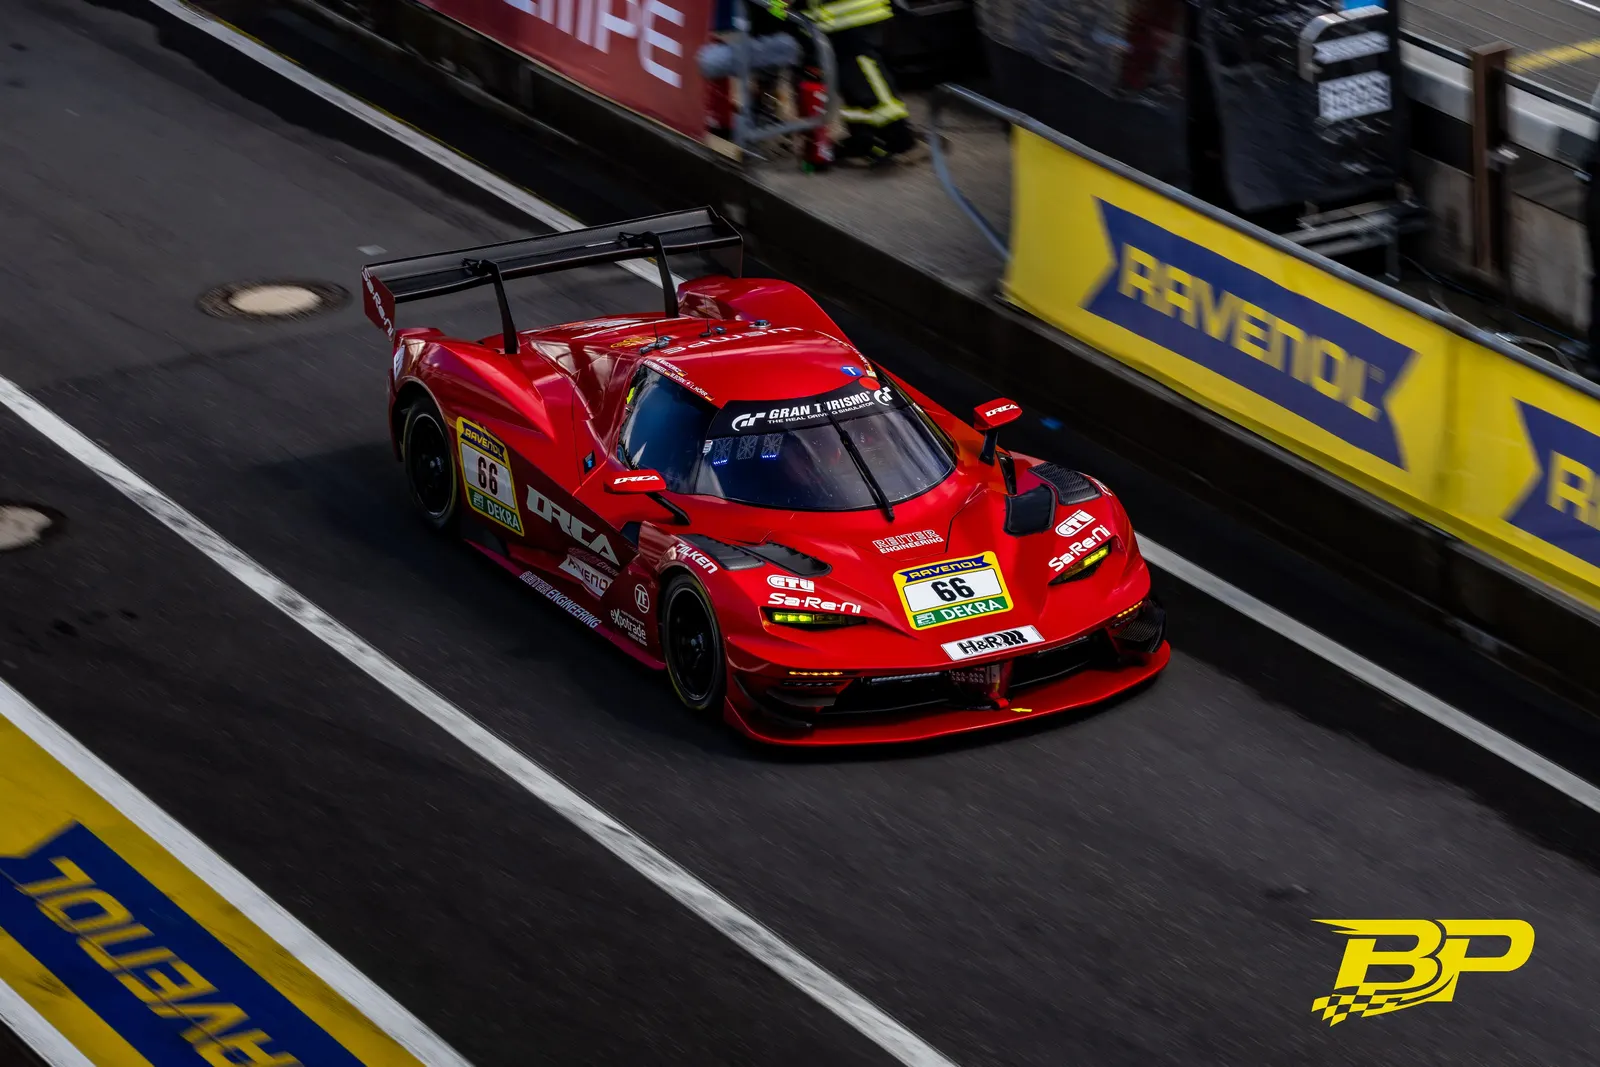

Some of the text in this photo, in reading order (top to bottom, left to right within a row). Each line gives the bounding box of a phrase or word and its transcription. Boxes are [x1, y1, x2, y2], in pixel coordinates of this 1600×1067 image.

[1118, 243, 1381, 421] RAVENOL
[842, 366, 856, 376] T
[769, 405, 811, 420] GRAN
[807, 410, 837, 419] DRIVIG
[838, 401, 875, 413] SIMULATOR
[465, 428, 503, 457] RAVENOL
[478, 456, 498, 496] 66
[487, 500, 520, 531] DEKRA
[1055, 509, 1096, 537] GTU
[872, 529, 940, 549] REITER
[879, 537, 944, 554] ENGINEERING
[675, 543, 718, 574] FALKEN
[909, 560, 985, 580] RAVENOL
[767, 575, 815, 593] GTU
[931, 577, 975, 602] 66
[546, 588, 601, 629] ENGINEERING
[940, 599, 1004, 621] DEKRA
[957, 634, 1004, 656] H&R
